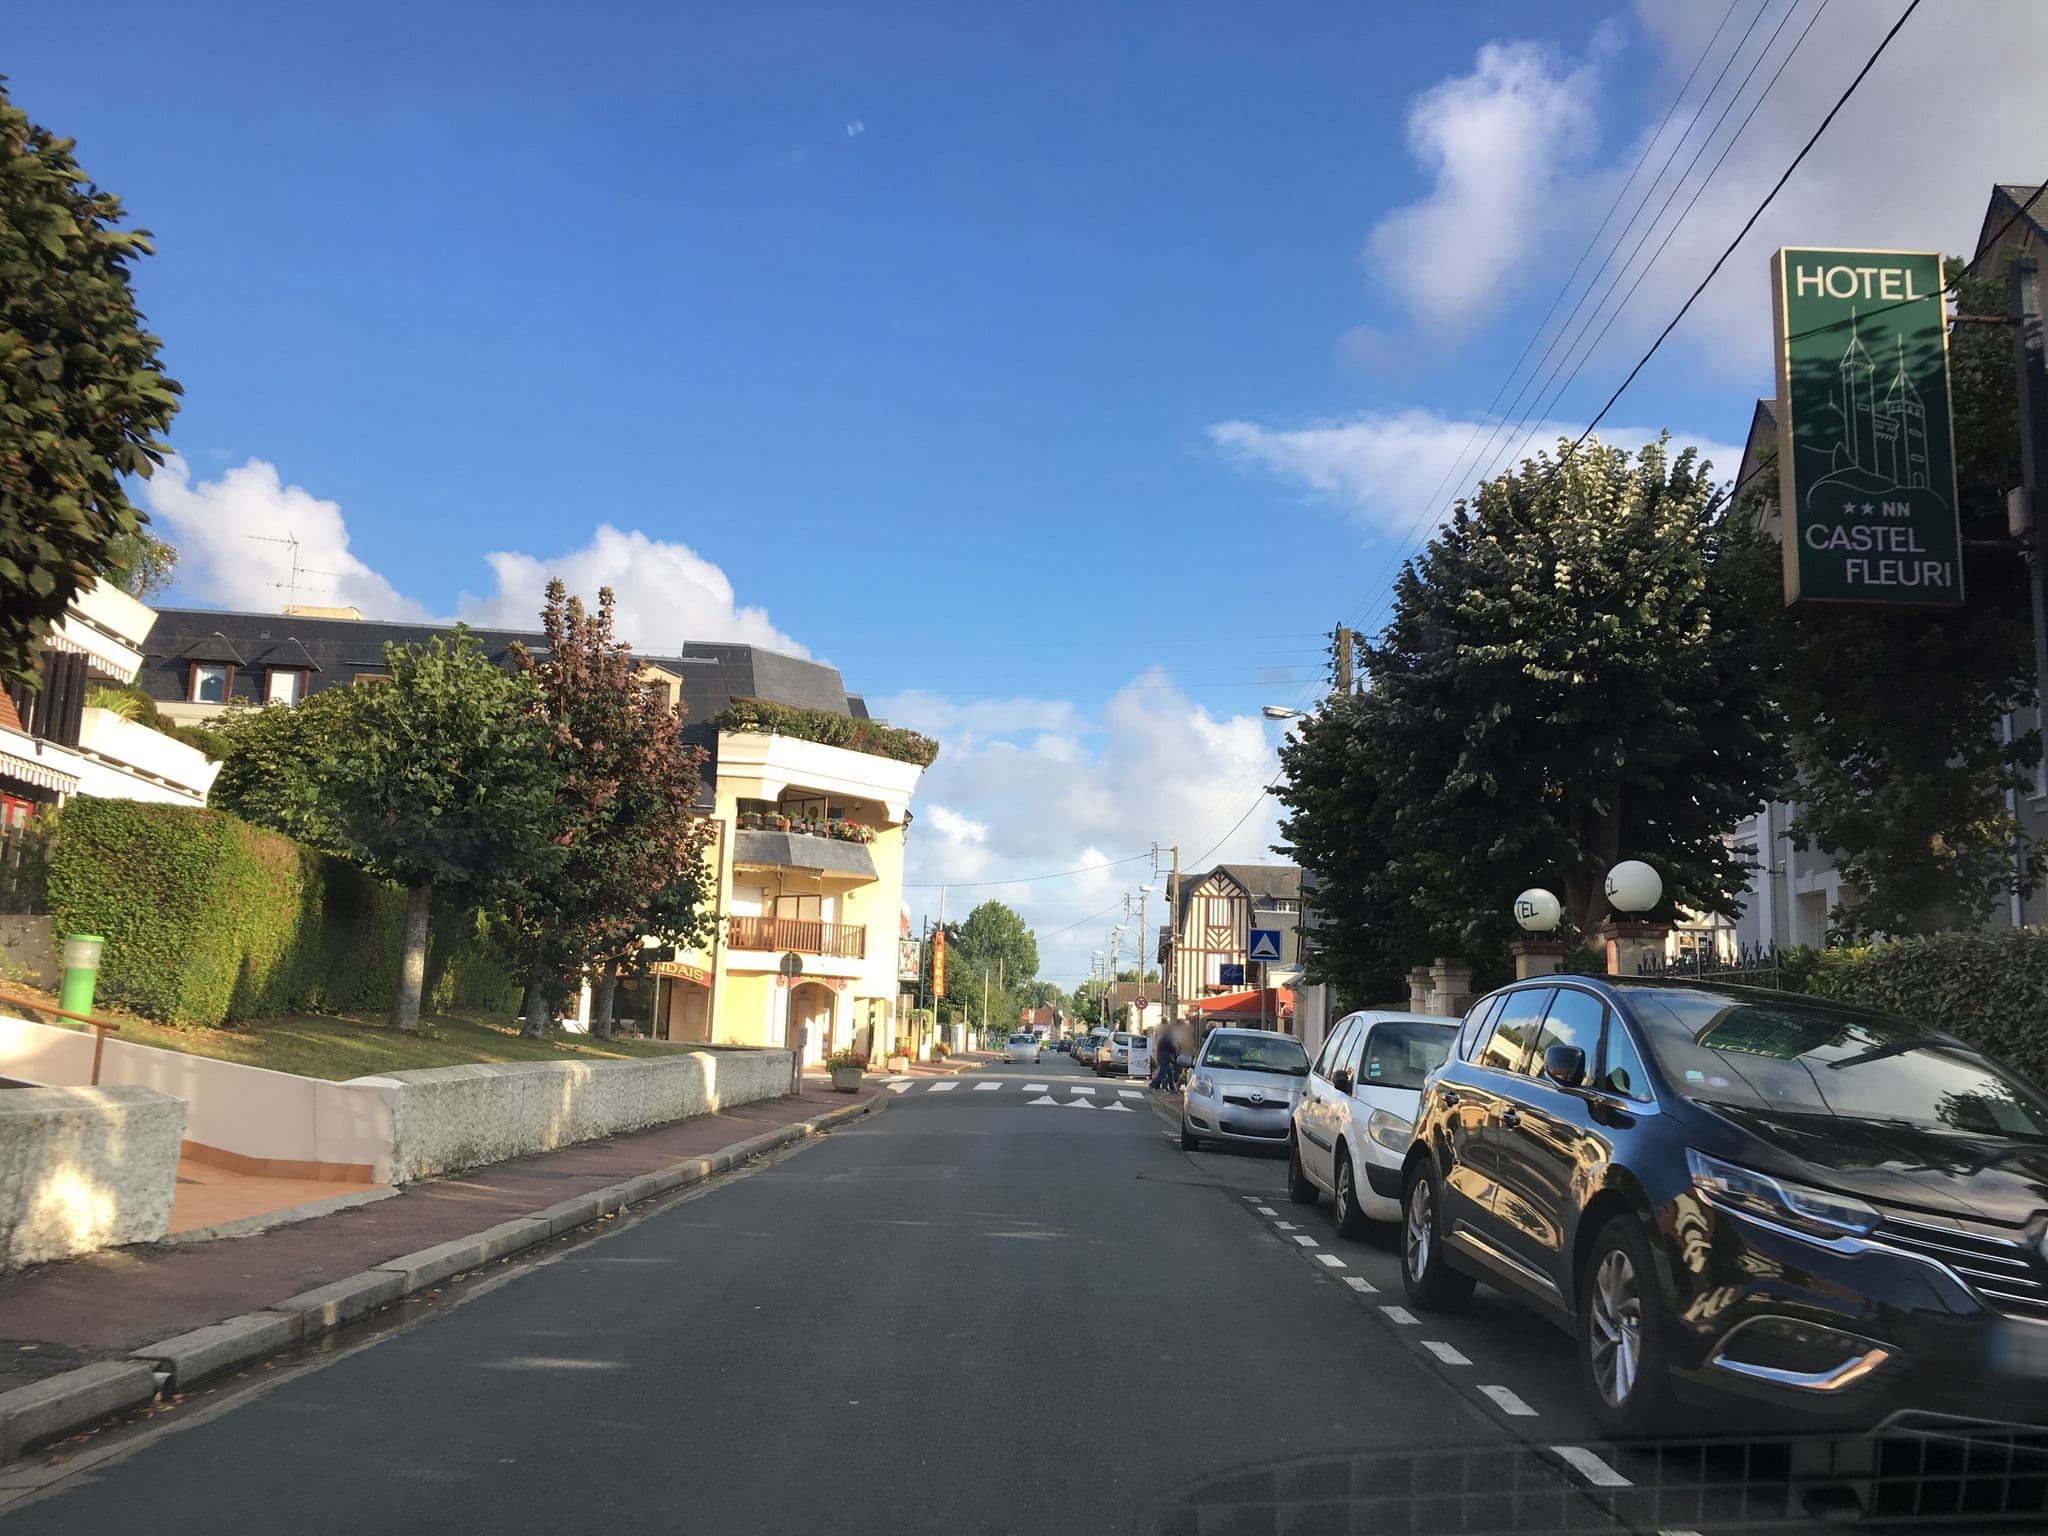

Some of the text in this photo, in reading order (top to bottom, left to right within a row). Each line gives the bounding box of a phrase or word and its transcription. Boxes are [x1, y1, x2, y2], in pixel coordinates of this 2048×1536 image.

[1796, 265, 1929, 301] HOTEL
[1882, 501, 1911, 517] NN
[1805, 523, 1926, 553] CASTEL
[1845, 558, 1953, 588] FLEURI
